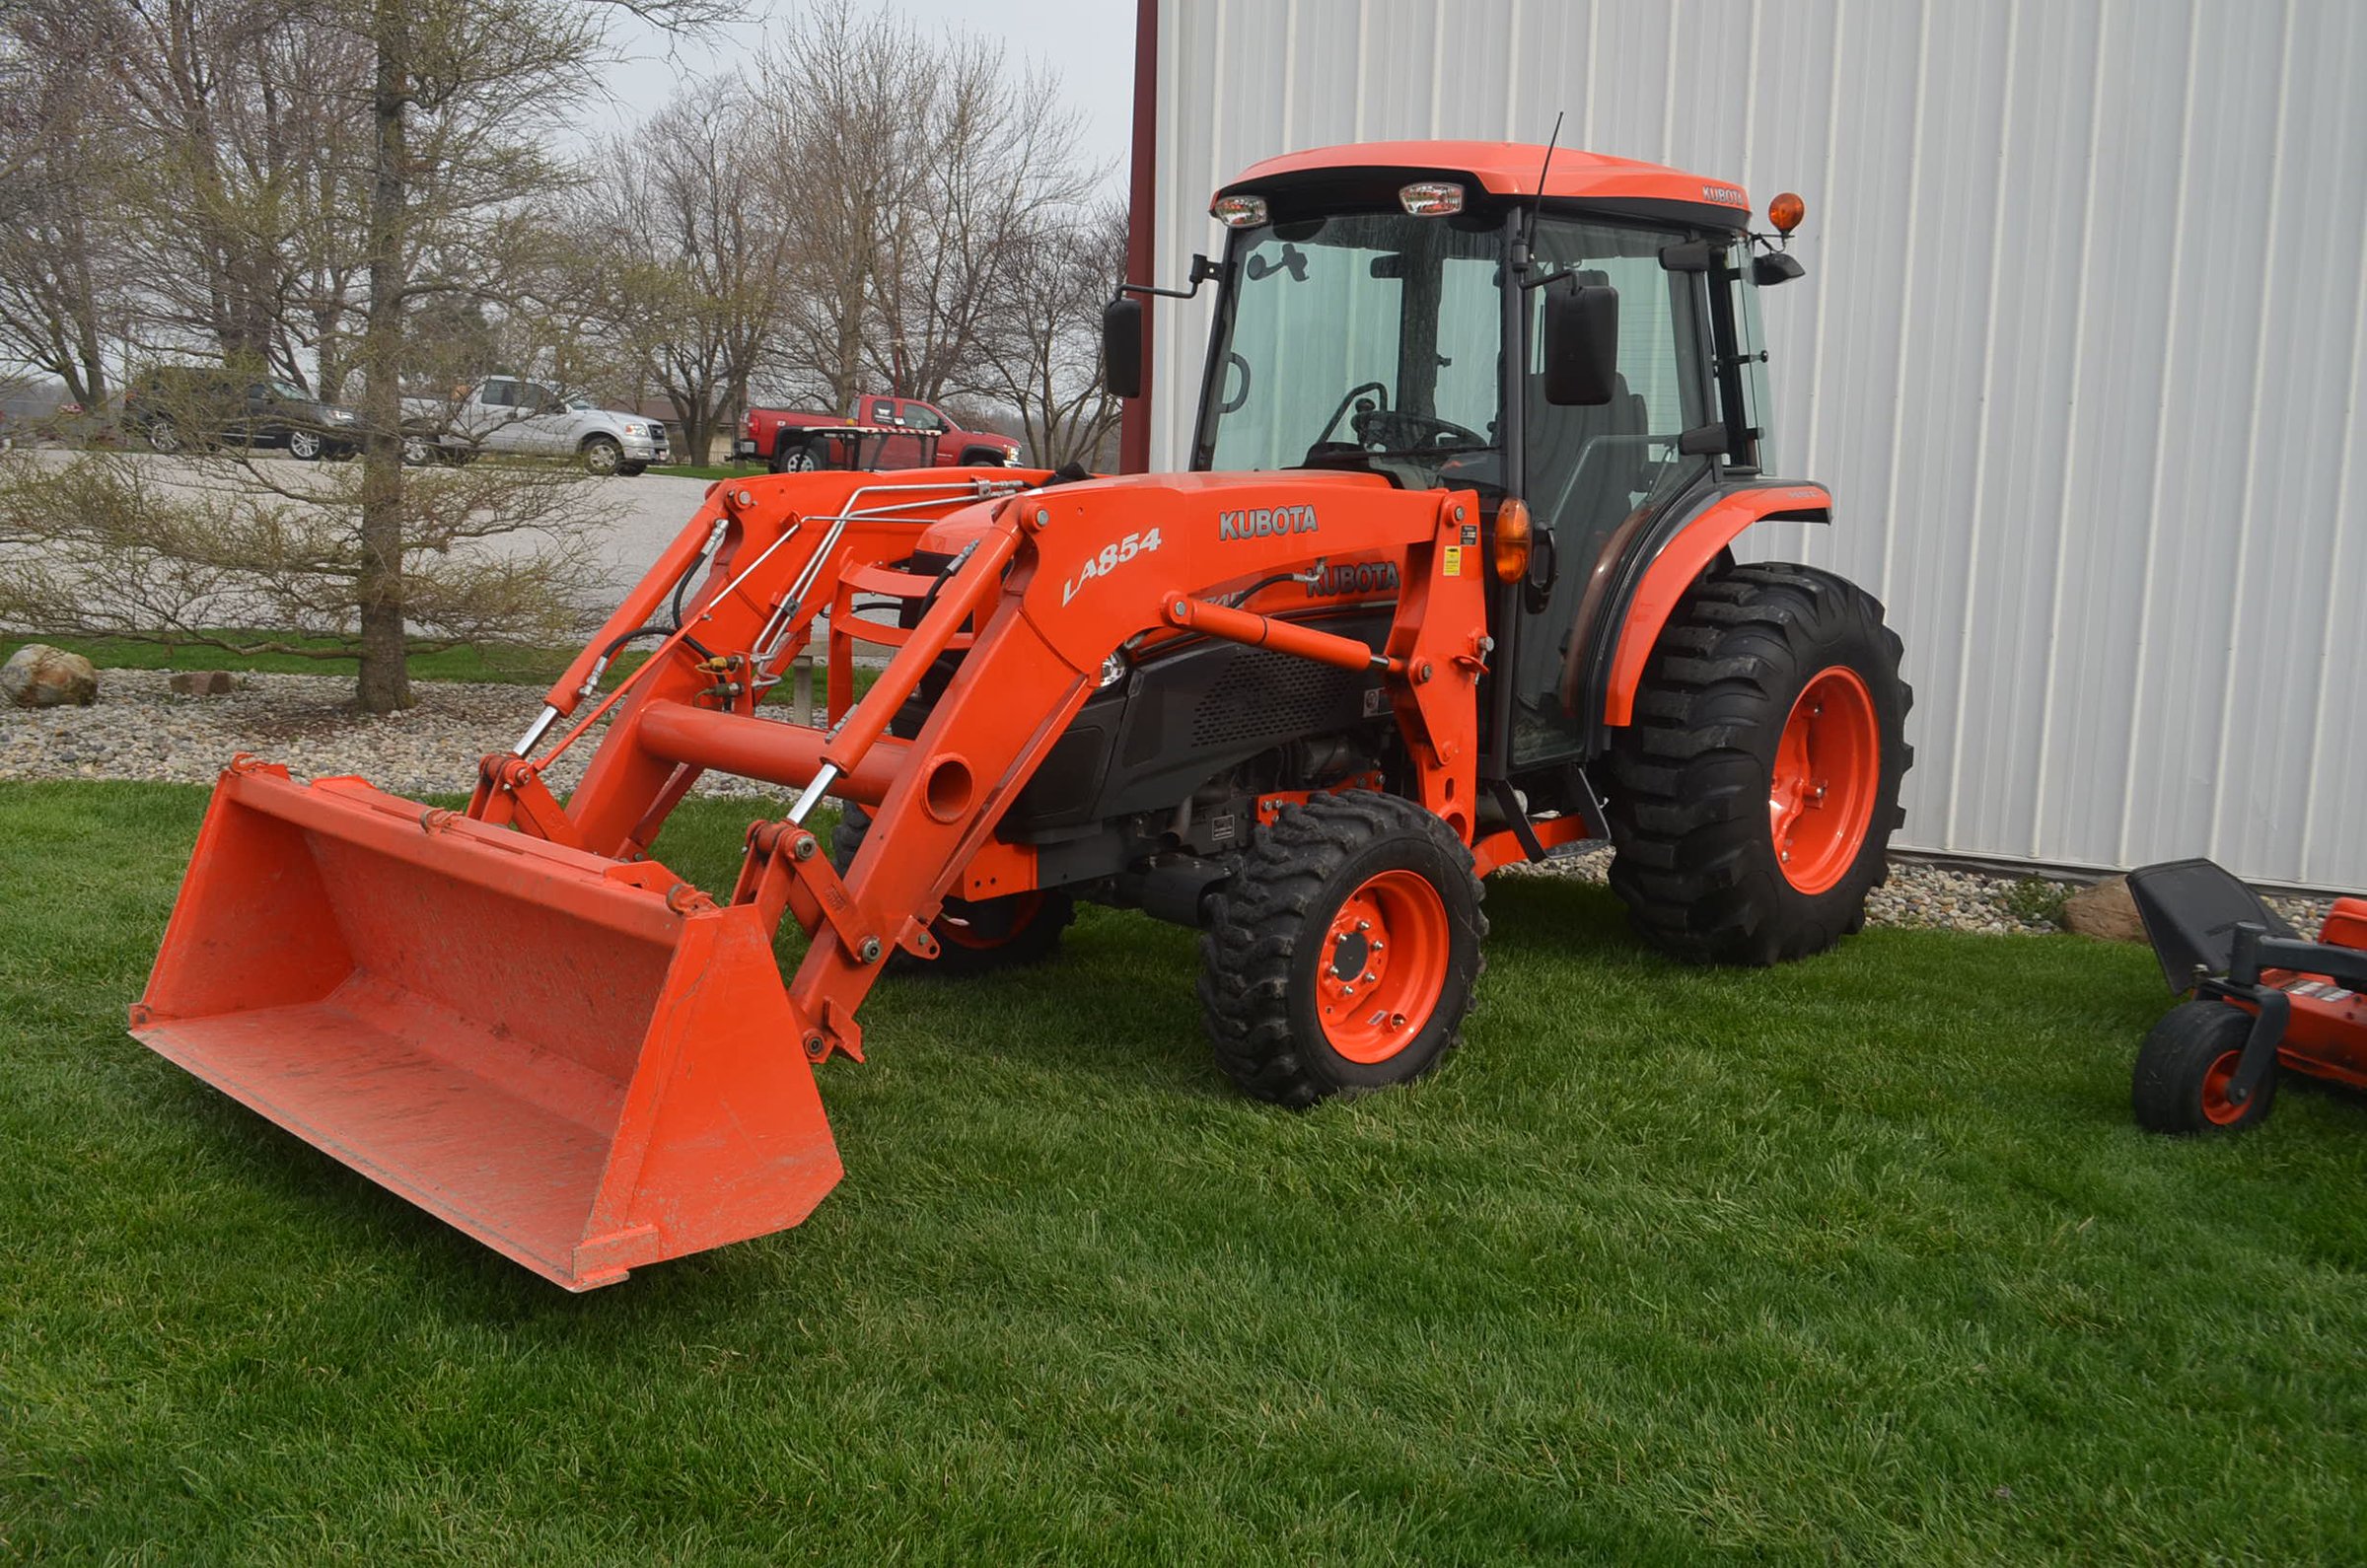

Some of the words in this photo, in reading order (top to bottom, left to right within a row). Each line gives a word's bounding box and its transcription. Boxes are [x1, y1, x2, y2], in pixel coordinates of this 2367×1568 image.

[1702, 185, 1744, 205] KUBOTA
[1220, 505, 1319, 540] KUBOTA
[1062, 528, 1162, 607] LA854
[1306, 561, 1399, 598] KUBOTA
